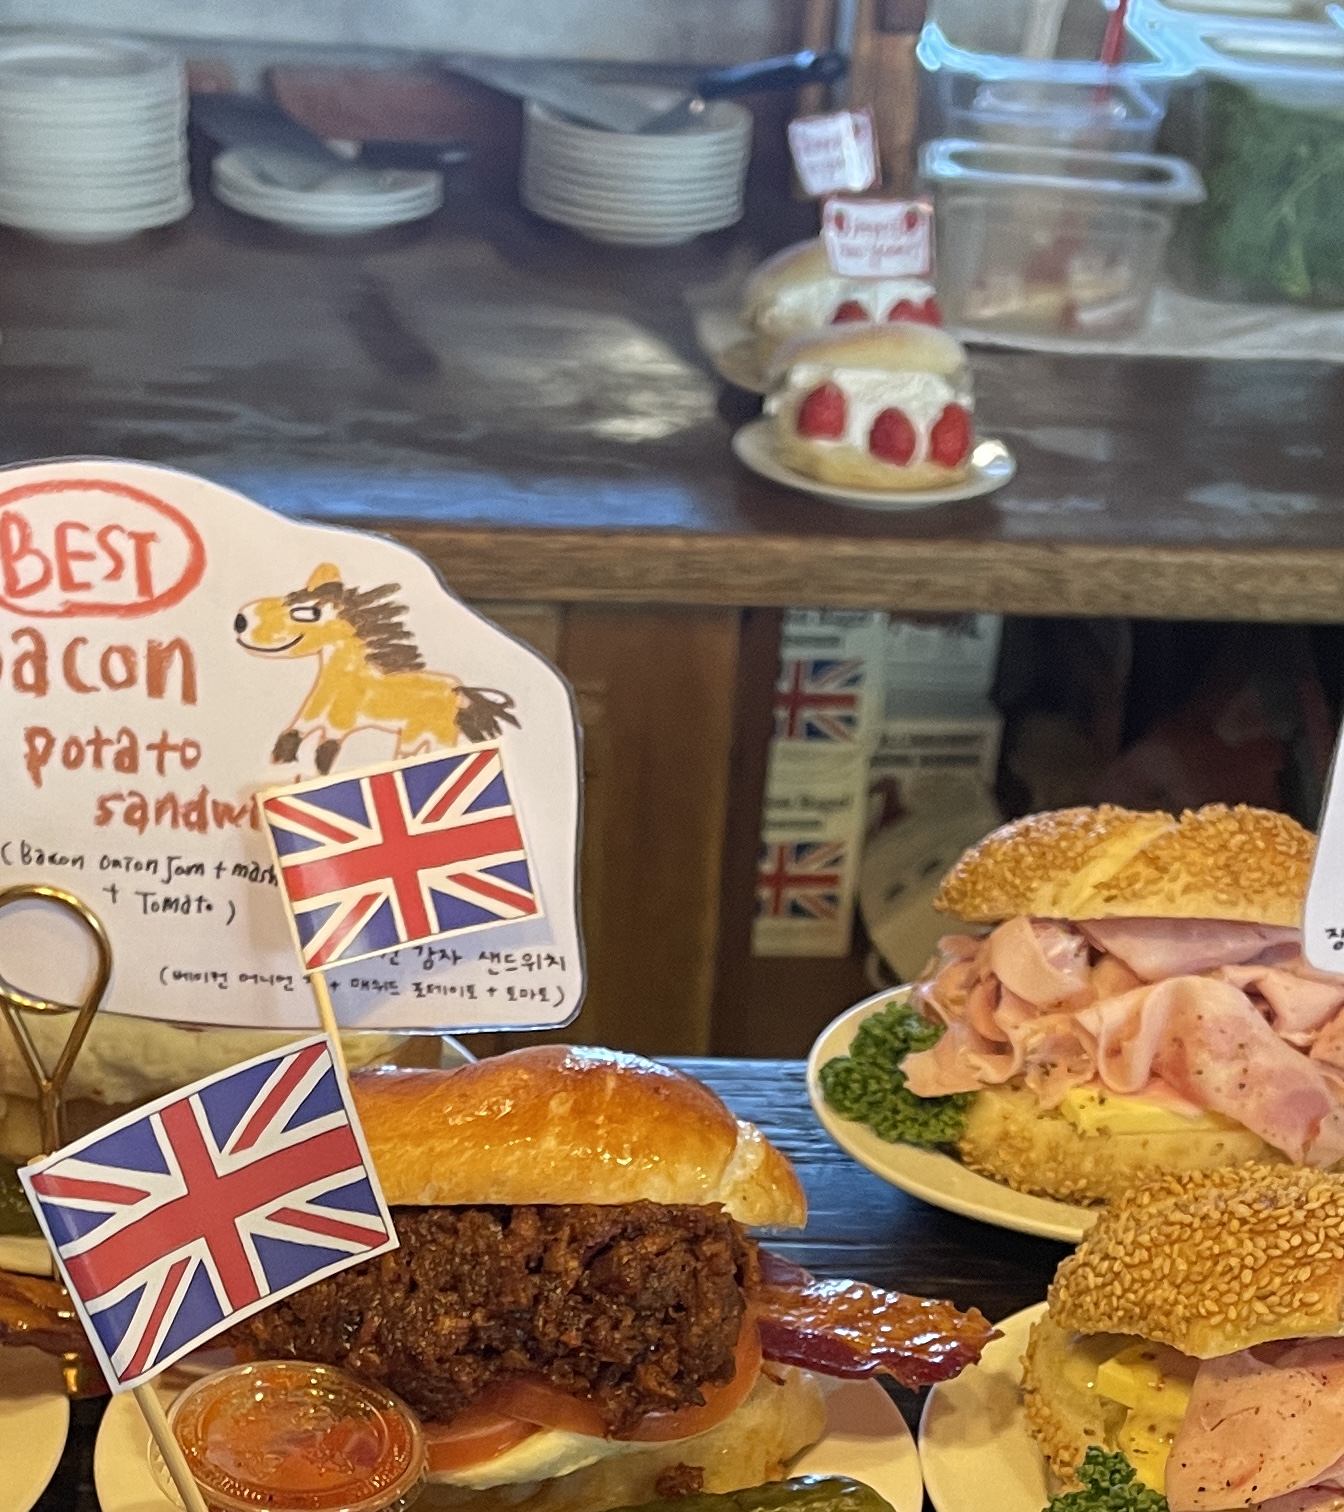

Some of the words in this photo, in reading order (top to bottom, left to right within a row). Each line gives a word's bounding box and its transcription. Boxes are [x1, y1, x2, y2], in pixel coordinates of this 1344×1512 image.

[23, 726, 202, 788] potato
[94, 784, 260, 835] sandwi
[231, 861, 278, 887] mash
[412, 945, 463, 970] 감자
[479, 951, 566, 975] 샌드위치
[239, 973, 293, 991] 어니언
